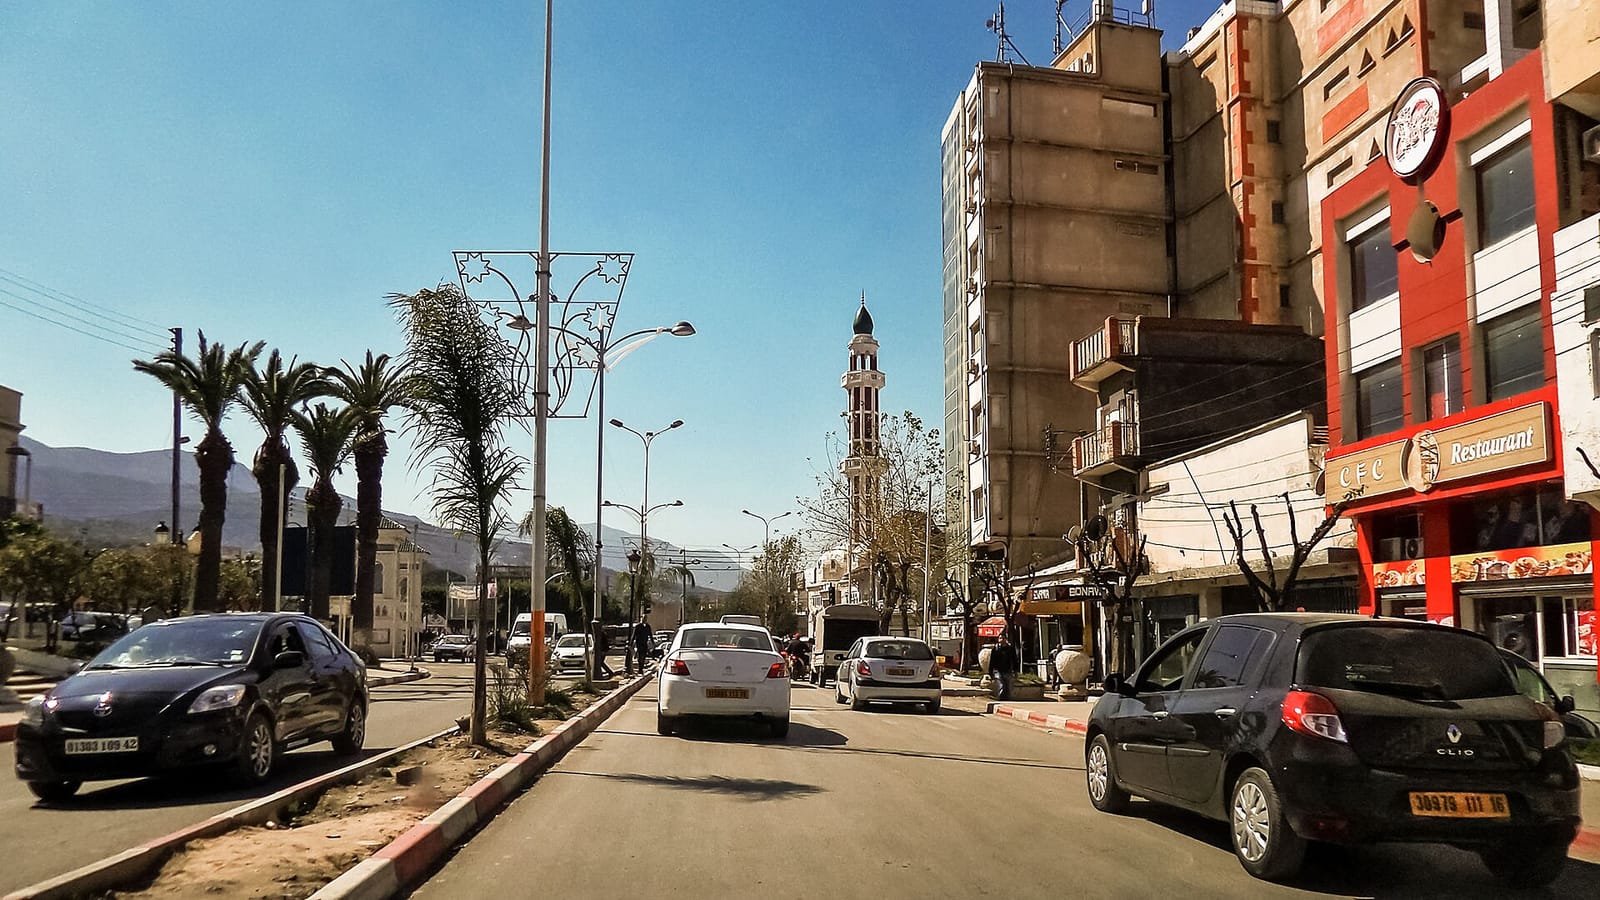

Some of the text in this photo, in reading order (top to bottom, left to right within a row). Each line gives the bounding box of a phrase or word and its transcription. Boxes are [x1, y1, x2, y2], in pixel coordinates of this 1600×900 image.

[1451, 425, 1533, 465] Restaurant
[122, 739, 137, 750] 42
[1436, 748, 1474, 756] CLIO
[1464, 795, 1484, 813] 111
[1489, 796, 1505, 814] 16
